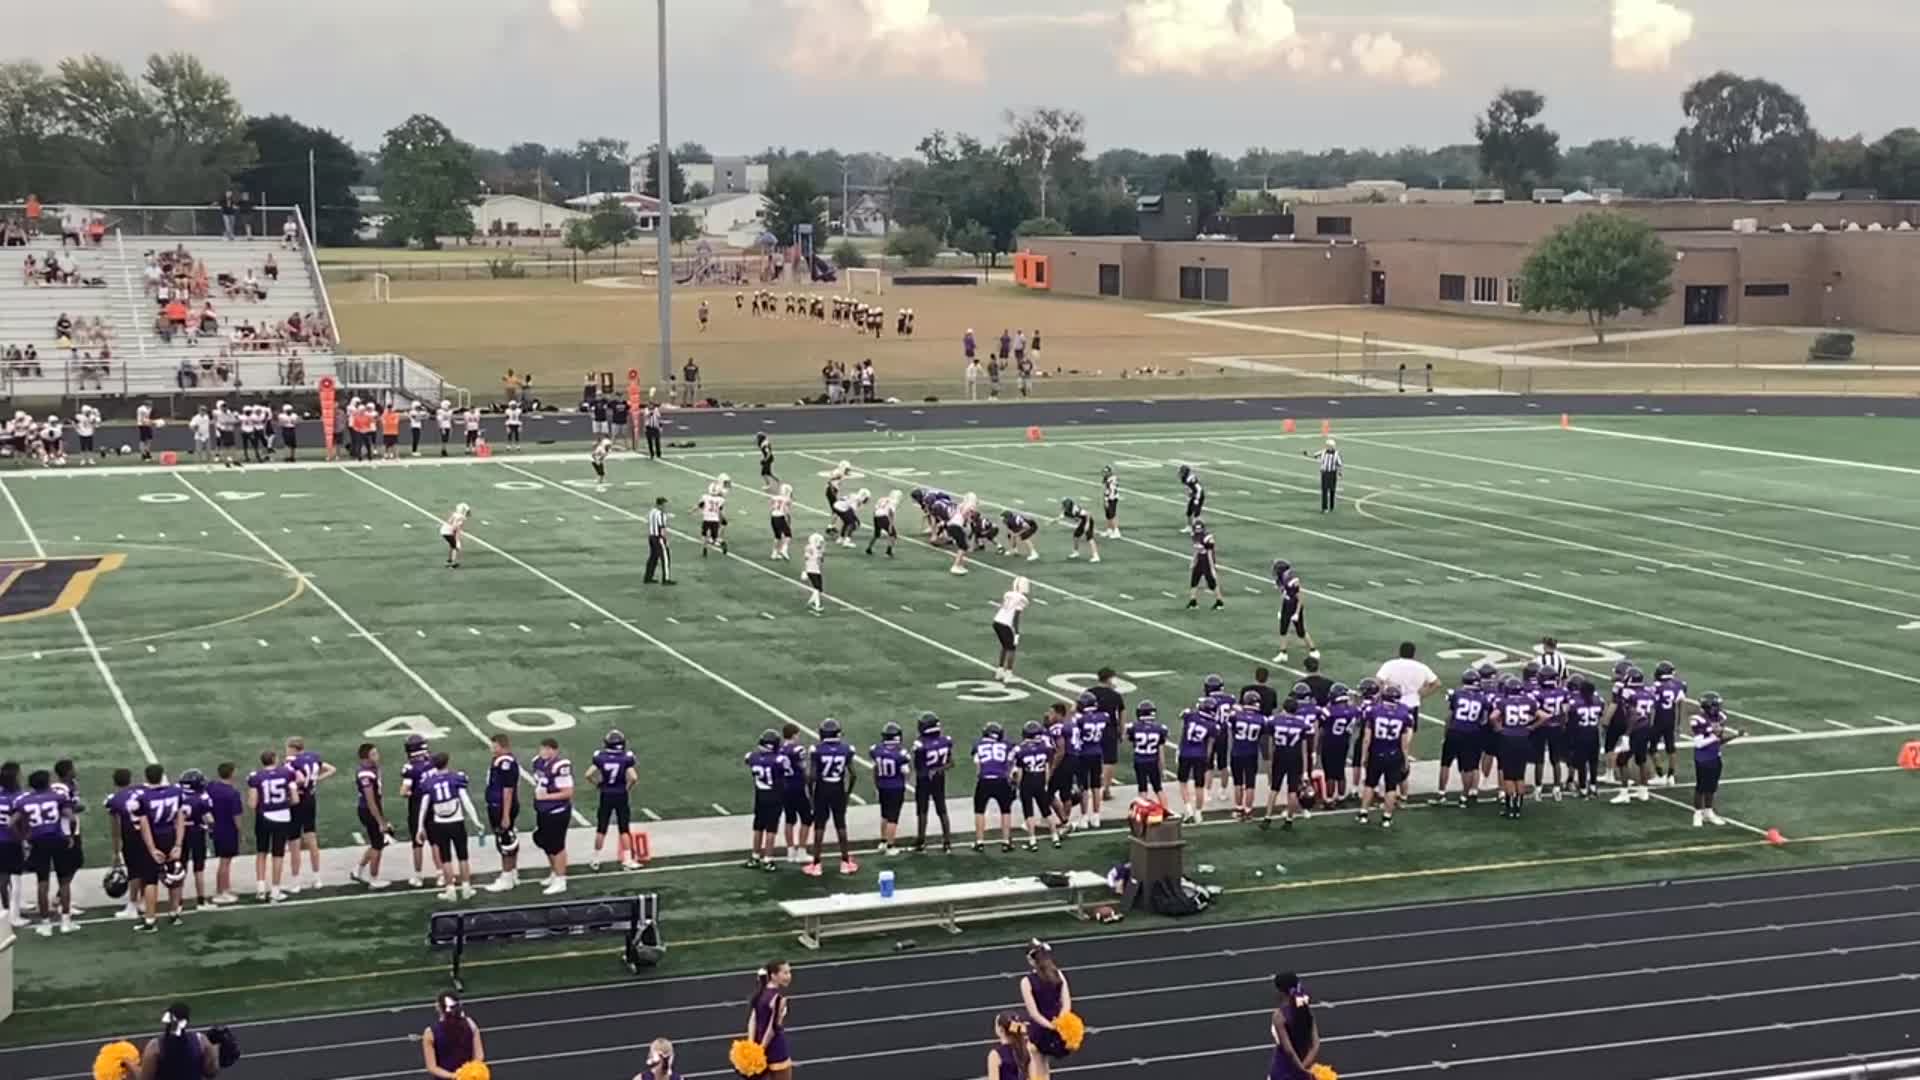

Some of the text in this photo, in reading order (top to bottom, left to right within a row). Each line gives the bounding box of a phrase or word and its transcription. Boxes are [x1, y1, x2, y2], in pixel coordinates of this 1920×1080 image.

[1456, 698, 1481, 721] 28
[1506, 705, 1530, 726] 65
[1577, 706, 1601, 726] 35
[1187, 721, 1208, 742] 13
[1235, 721, 1262, 742] 30
[1274, 725, 1302, 747] 57
[1375, 716, 1403, 740] 63
[977, 743, 1007, 763] 56
[1134, 732, 1160, 755] 22
[604, 762, 621, 785] 7
[821, 755, 846, 778] 73
[876, 757, 896, 777] 10
[261, 777, 289, 805] 15
[432, 782, 452, 801] 11
[23, 800, 60, 828] 33
[149, 796, 179, 824] 77
